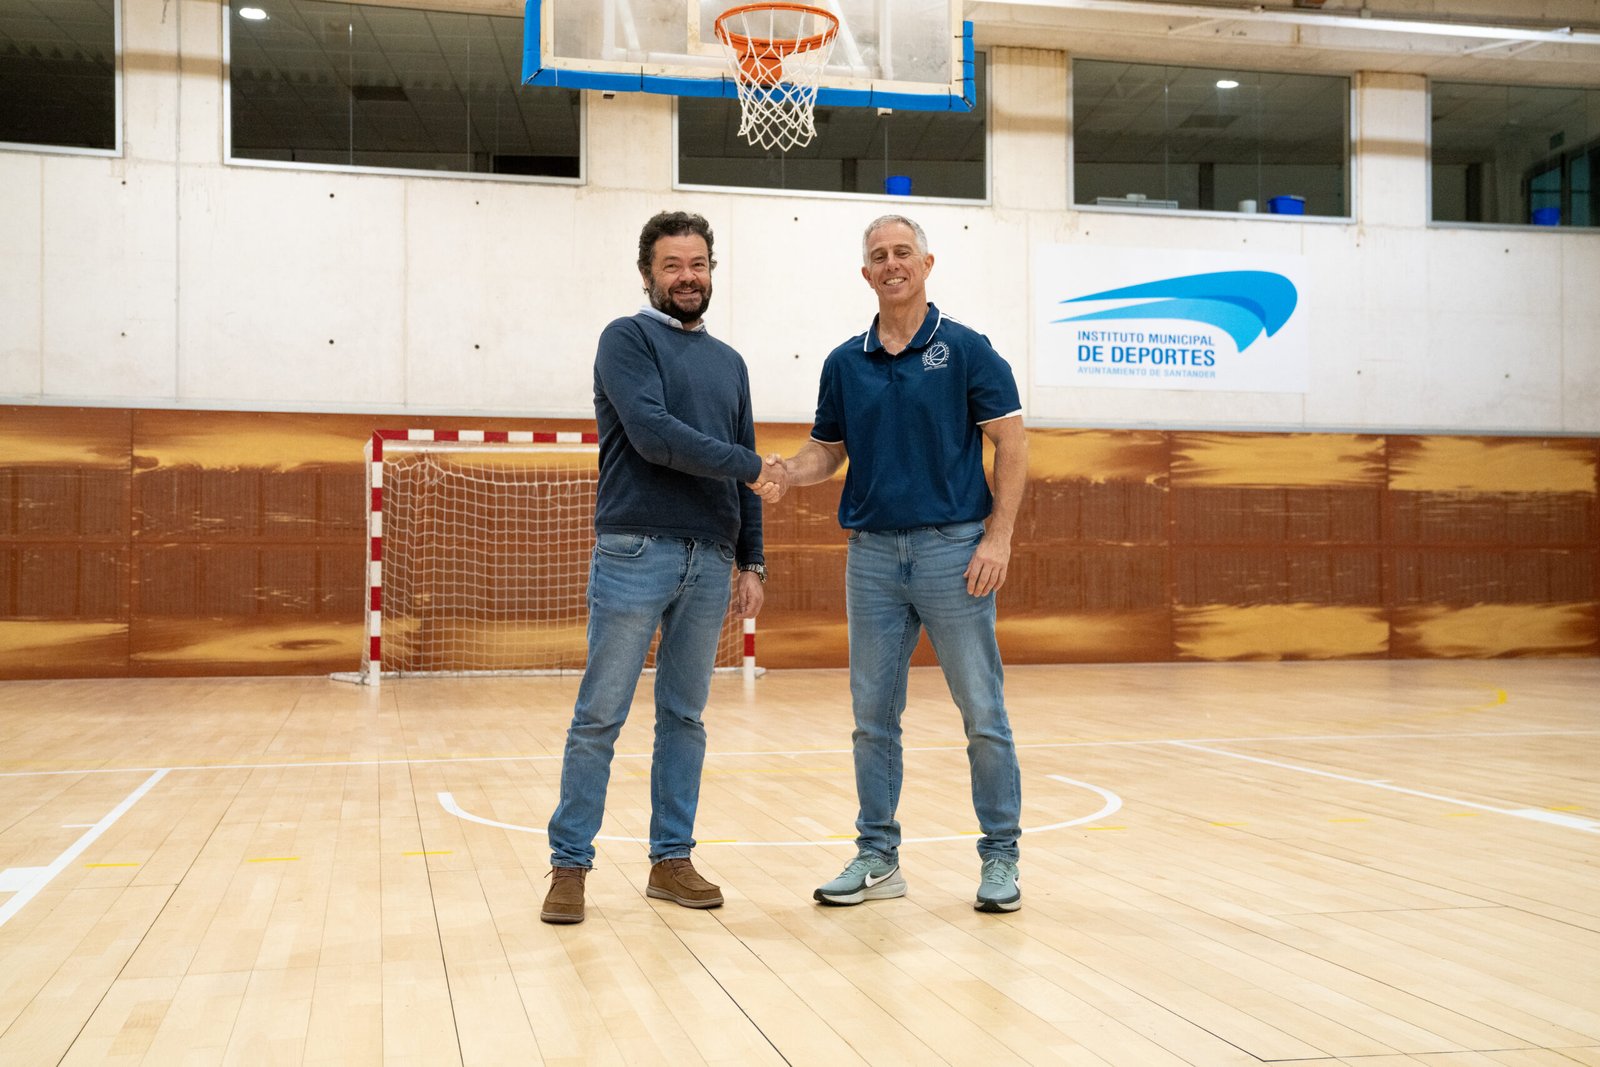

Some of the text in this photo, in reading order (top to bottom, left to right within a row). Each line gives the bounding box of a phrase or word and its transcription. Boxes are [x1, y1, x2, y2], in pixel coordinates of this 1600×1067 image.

[1078, 330, 1216, 346] INSTITUTO MUNICIPAL
[1078, 345, 1216, 367] DE DEPORTES
[1077, 366, 1216, 379] AYUNTAMIENTO DE SANTANDER
